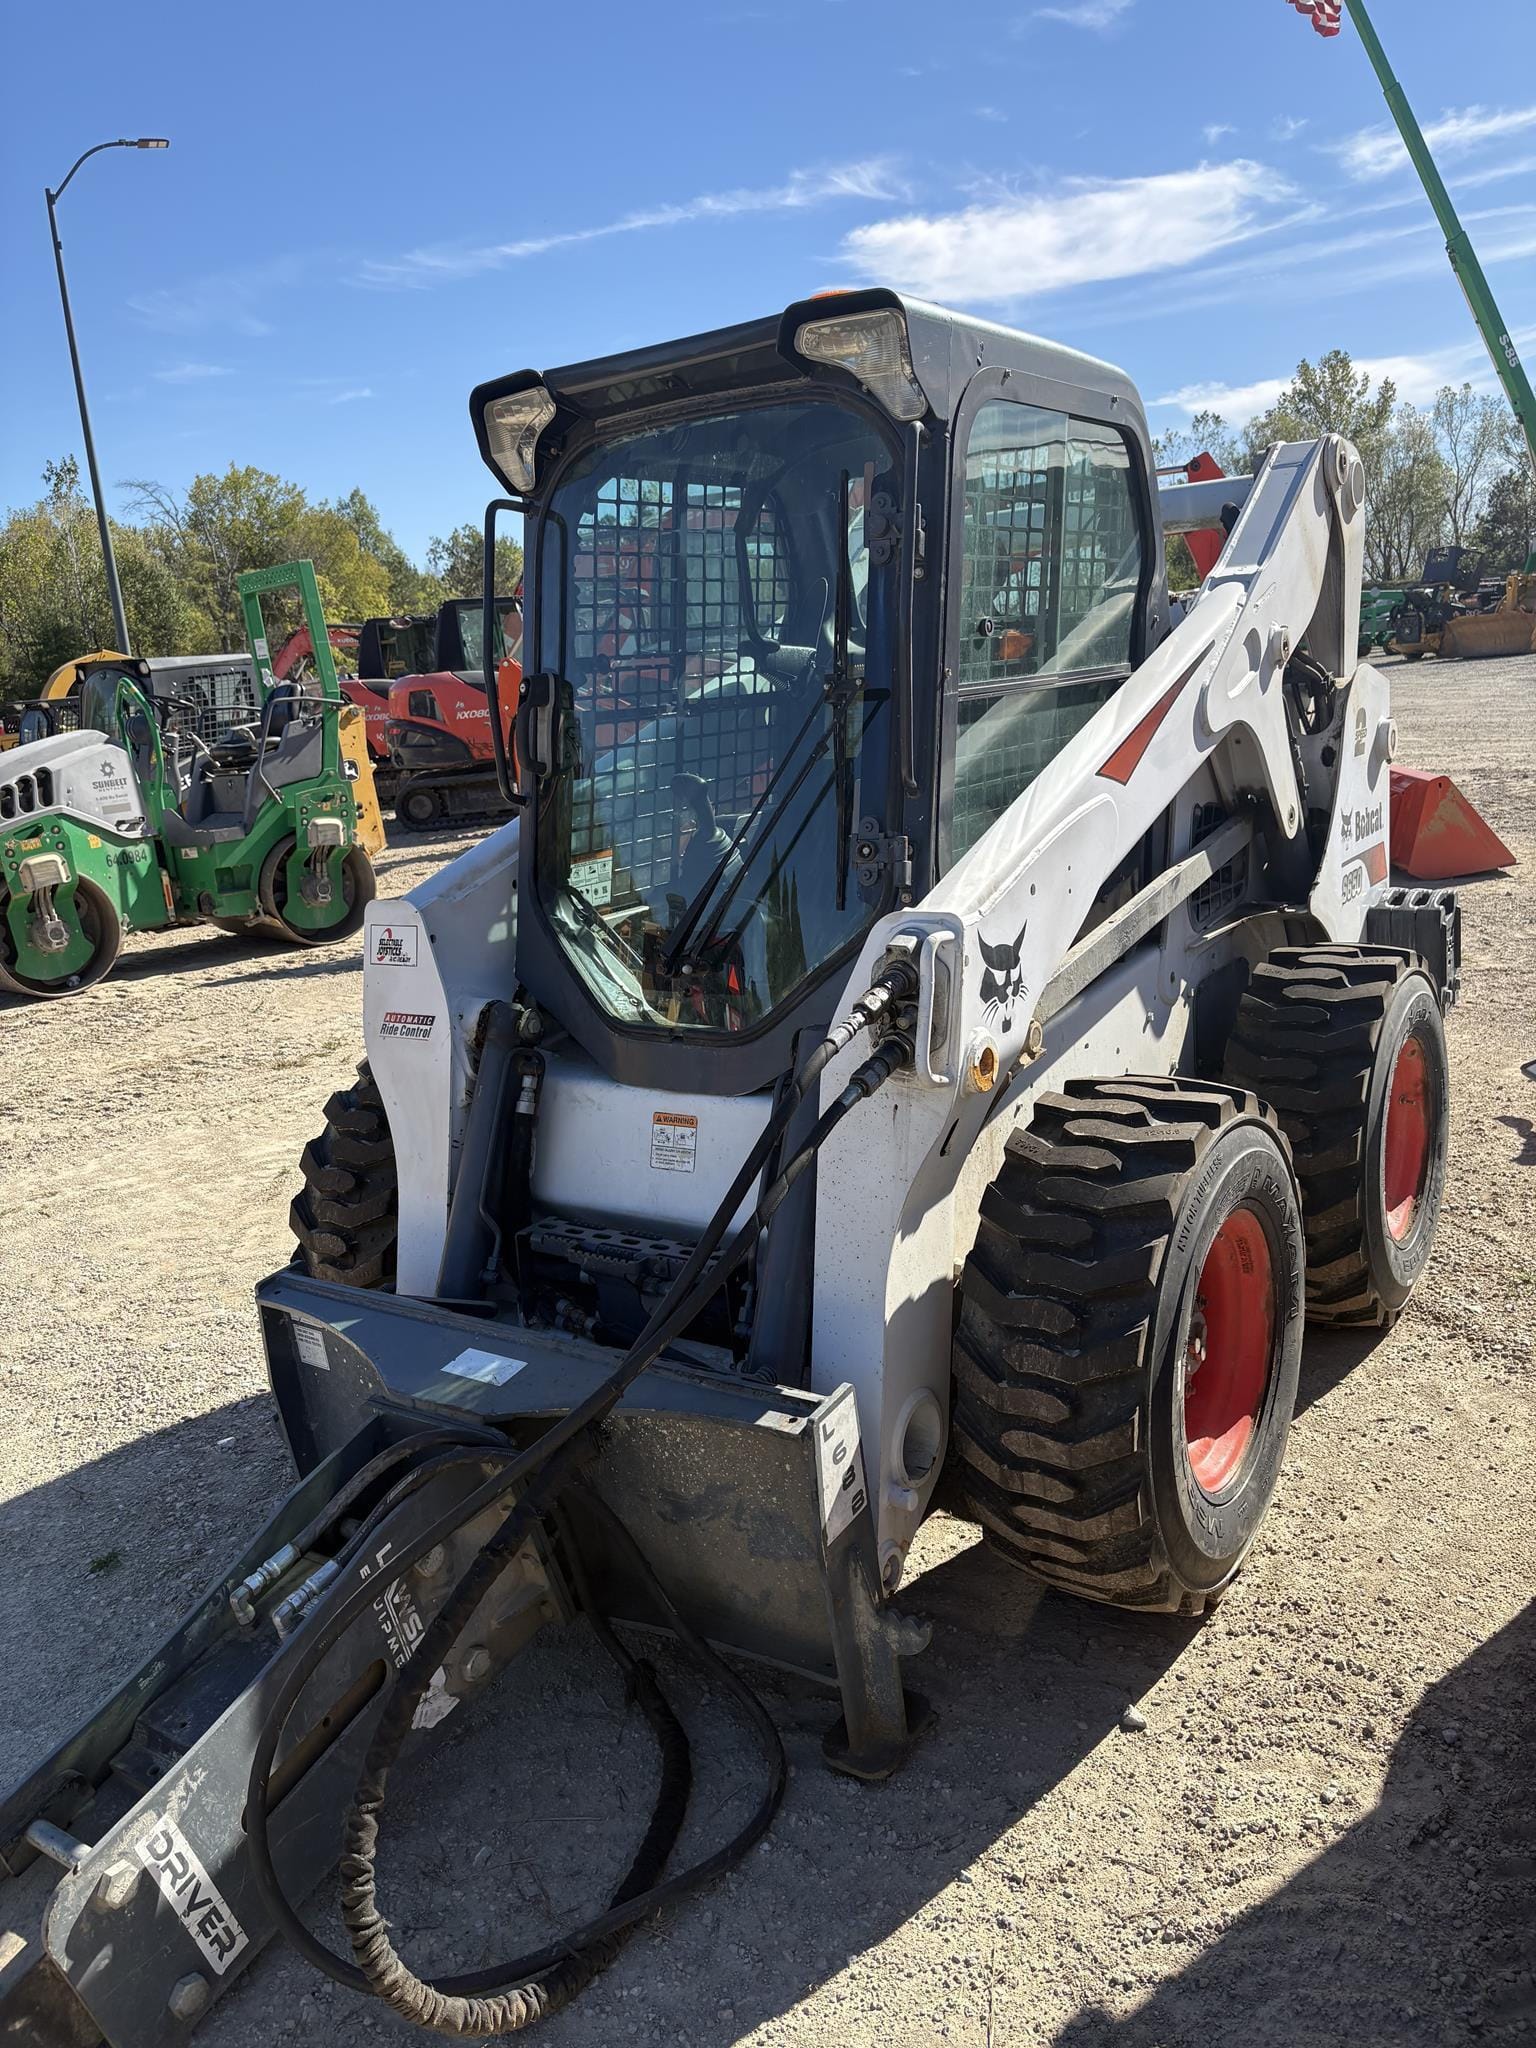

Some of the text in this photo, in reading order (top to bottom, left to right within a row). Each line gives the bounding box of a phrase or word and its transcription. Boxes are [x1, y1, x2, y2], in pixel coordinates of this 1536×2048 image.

[1499, 334, 1519, 368] S-85
[92, 777, 128, 790] SUNBELT
[1355, 802, 1383, 842] Bobcat
[384, 1013, 434, 1026] AUTOMATIC
[379, 1023, 432, 1039] Ride Control
[663, 1114, 695, 1126] WARNING
[146, 1829, 236, 1963] DRIVER
